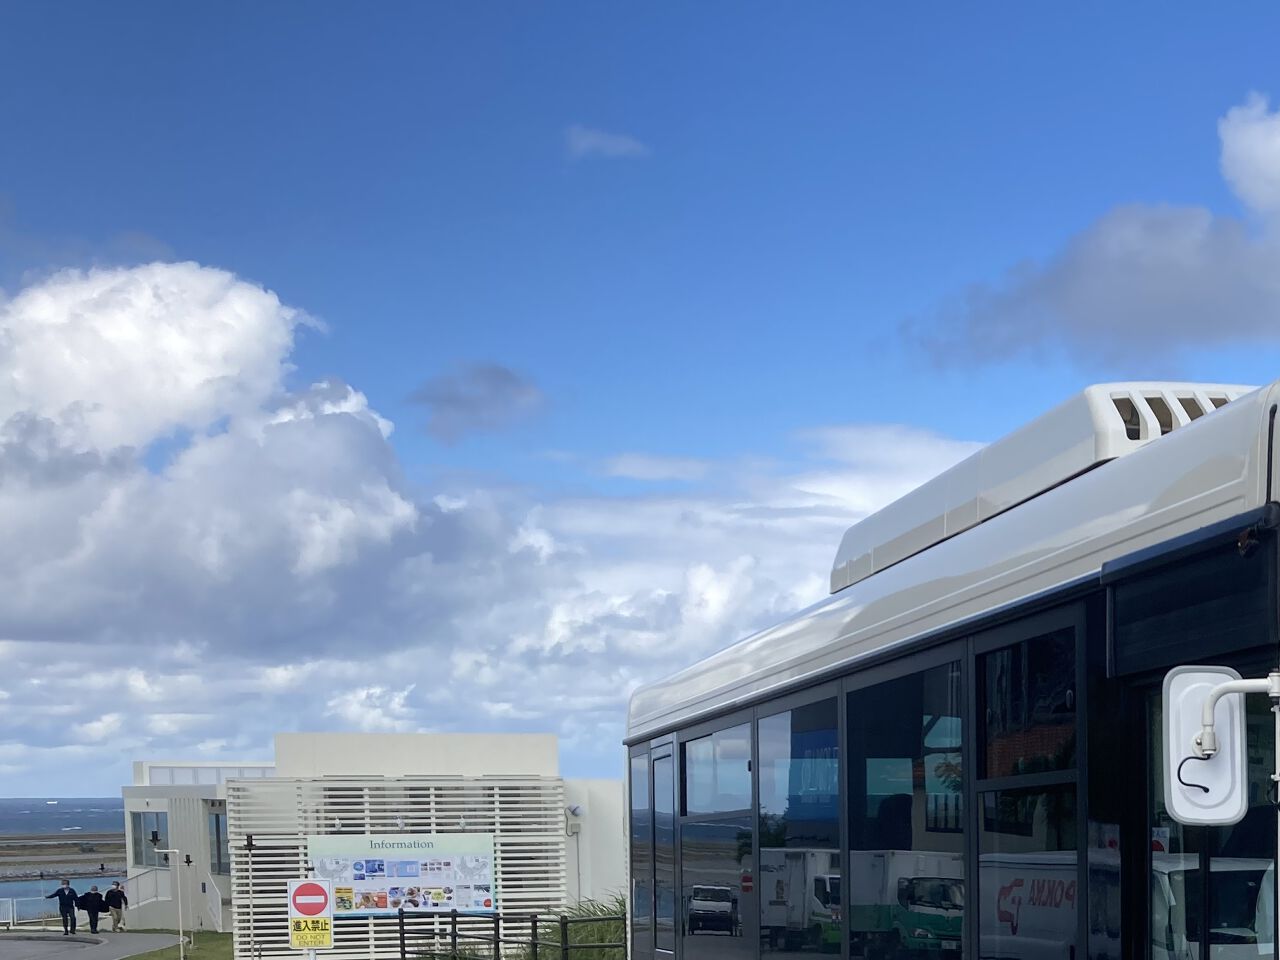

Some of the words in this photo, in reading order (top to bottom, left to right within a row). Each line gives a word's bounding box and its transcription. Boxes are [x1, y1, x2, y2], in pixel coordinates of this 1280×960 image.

[370, 839, 434, 849] Information
[292, 919, 329, 932] 進入禁止
